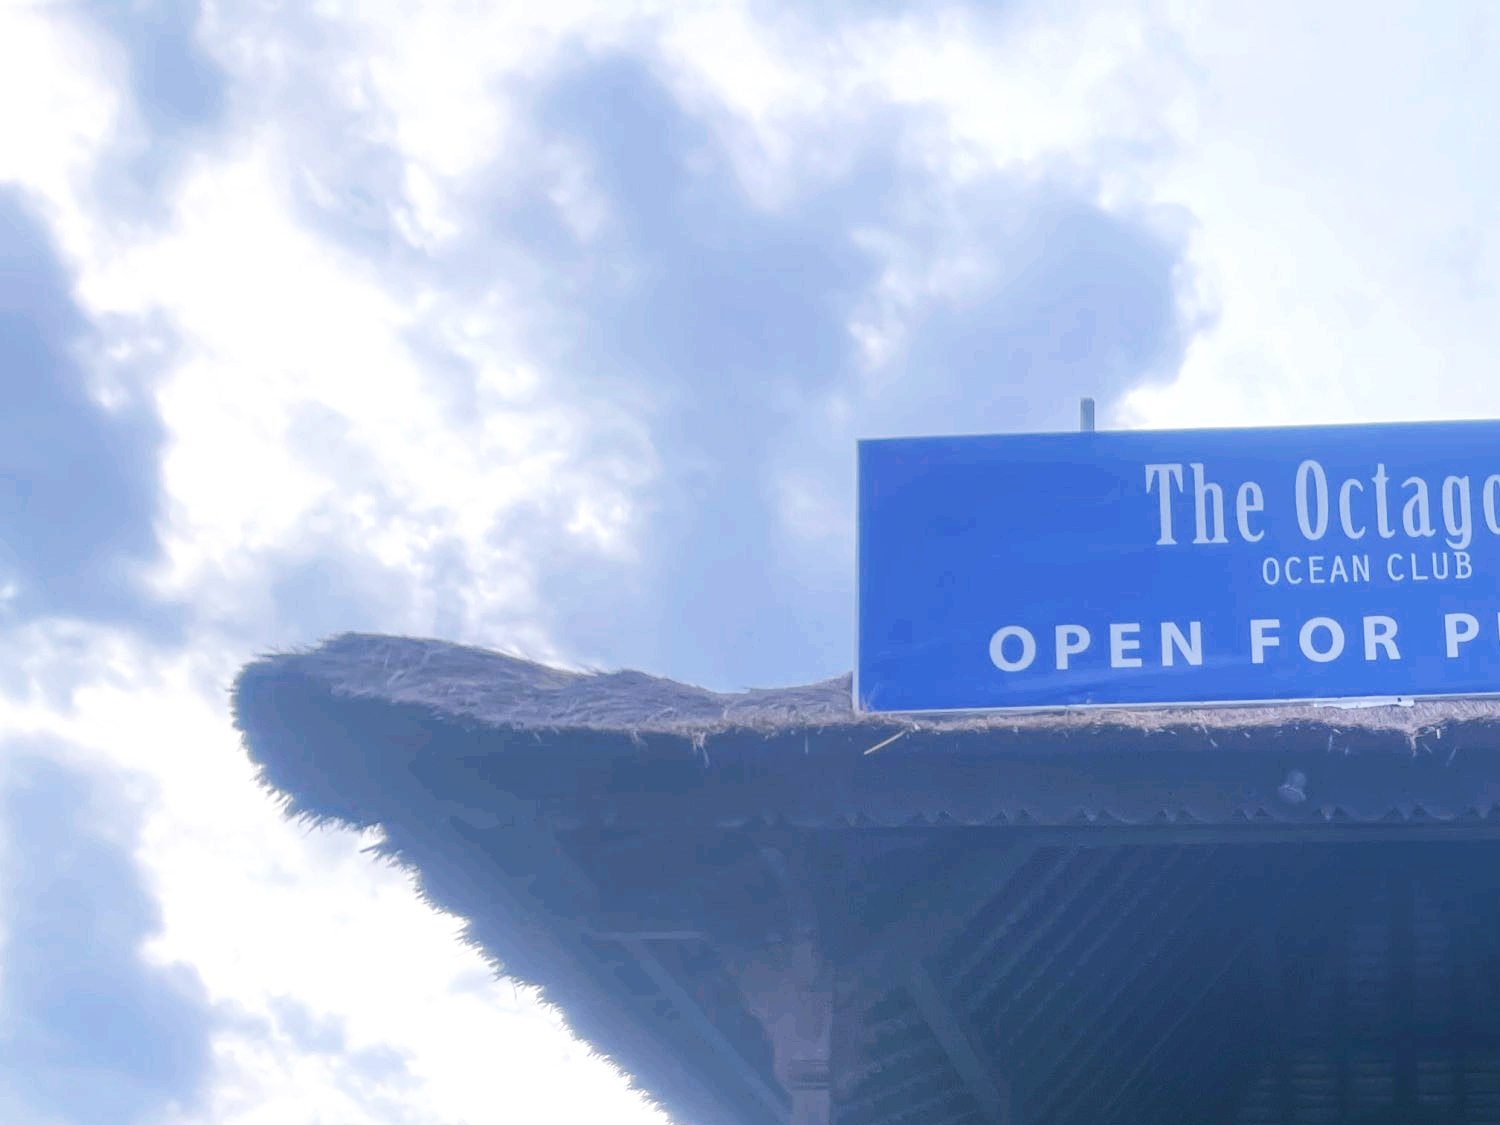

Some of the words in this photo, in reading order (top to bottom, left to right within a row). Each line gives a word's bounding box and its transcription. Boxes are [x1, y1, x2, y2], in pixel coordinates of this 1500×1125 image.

[1144, 462, 1266, 546] The
[1261, 555, 1371, 586] OCEAN
[1386, 551, 1474, 582] CLUB
[988, 621, 1204, 673] OPEN
[1251, 615, 1404, 665] FOR
